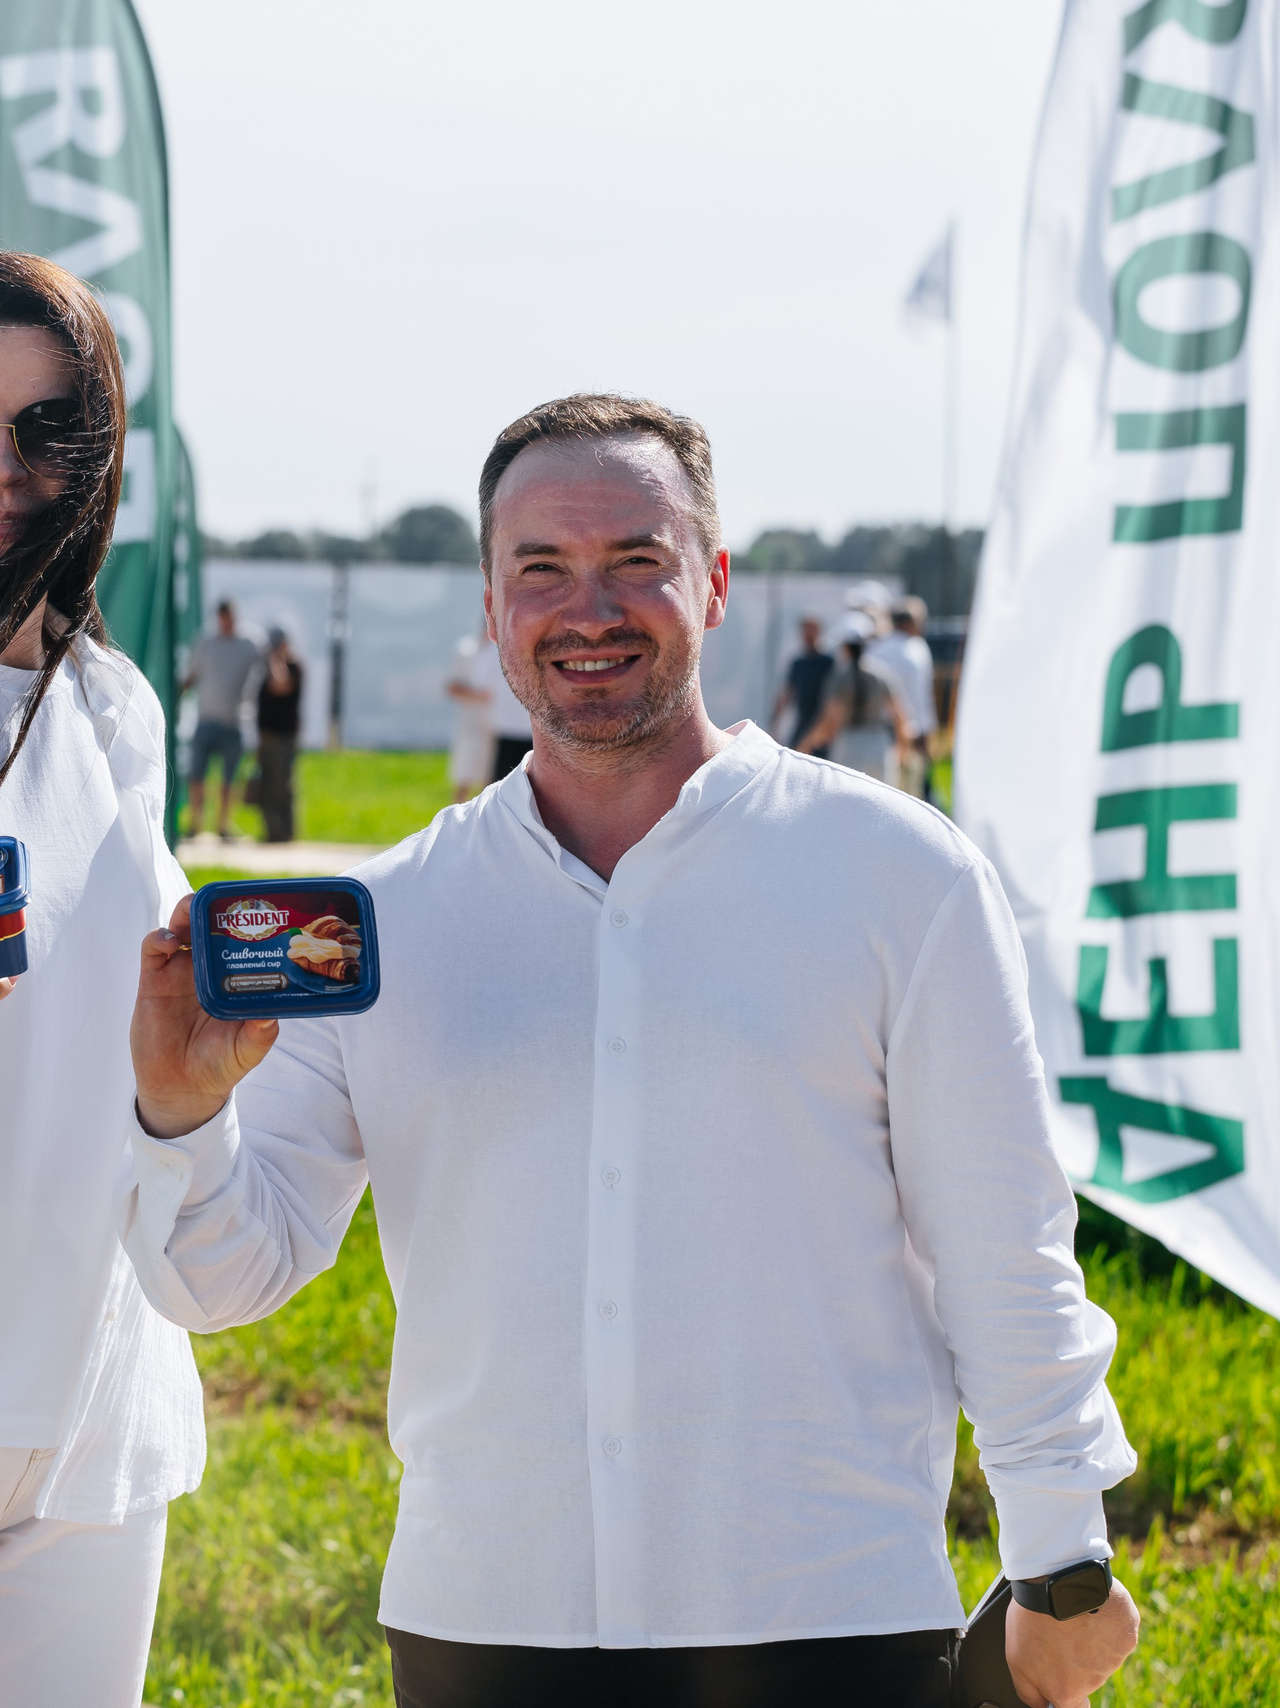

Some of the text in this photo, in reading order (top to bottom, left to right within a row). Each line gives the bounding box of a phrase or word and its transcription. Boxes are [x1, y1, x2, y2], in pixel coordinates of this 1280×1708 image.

[217, 910, 289, 929] PRÉSIDENT
[221, 947, 284, 960] Сливочный
[266, 960, 281, 970] сыр
